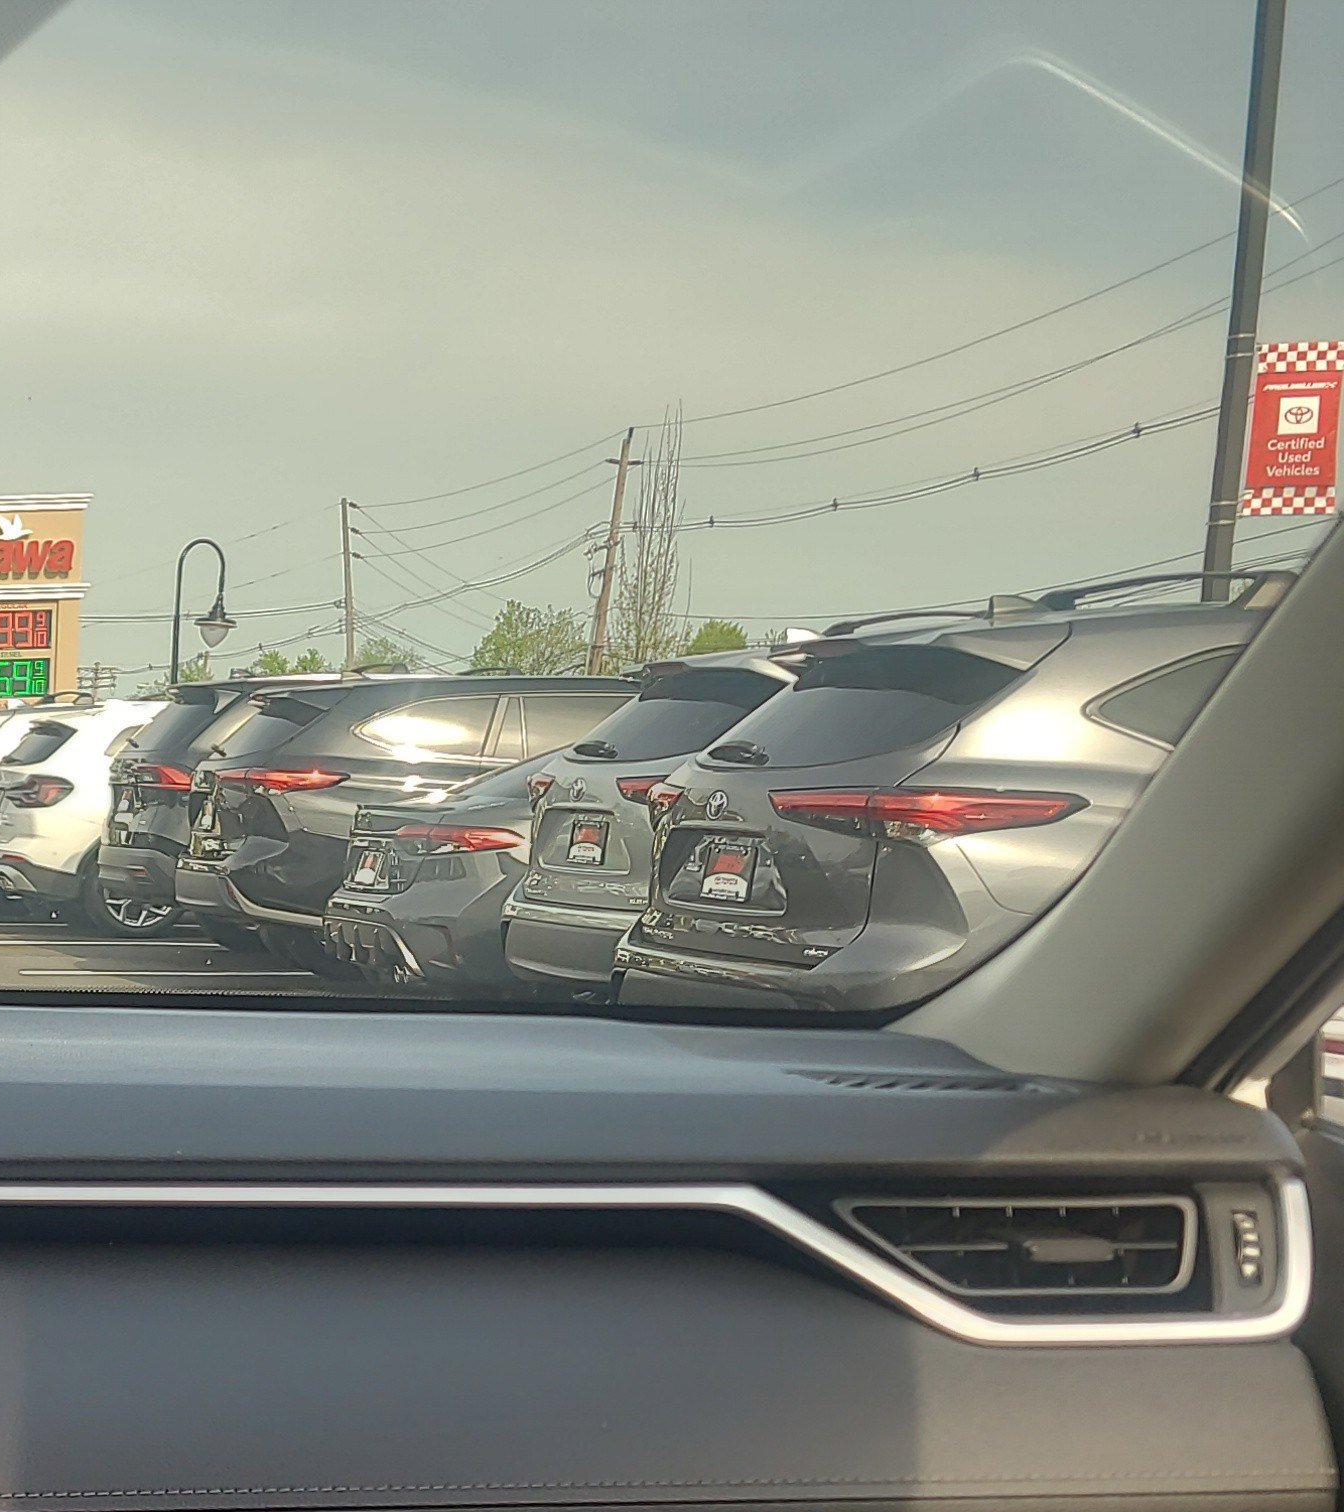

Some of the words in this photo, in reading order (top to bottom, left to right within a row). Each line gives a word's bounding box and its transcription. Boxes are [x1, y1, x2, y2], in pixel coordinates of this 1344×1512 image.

[1267, 436, 1325, 451] Certified
[1278, 450, 1312, 463] Used
[1265, 464, 1320, 477] Vehicles
